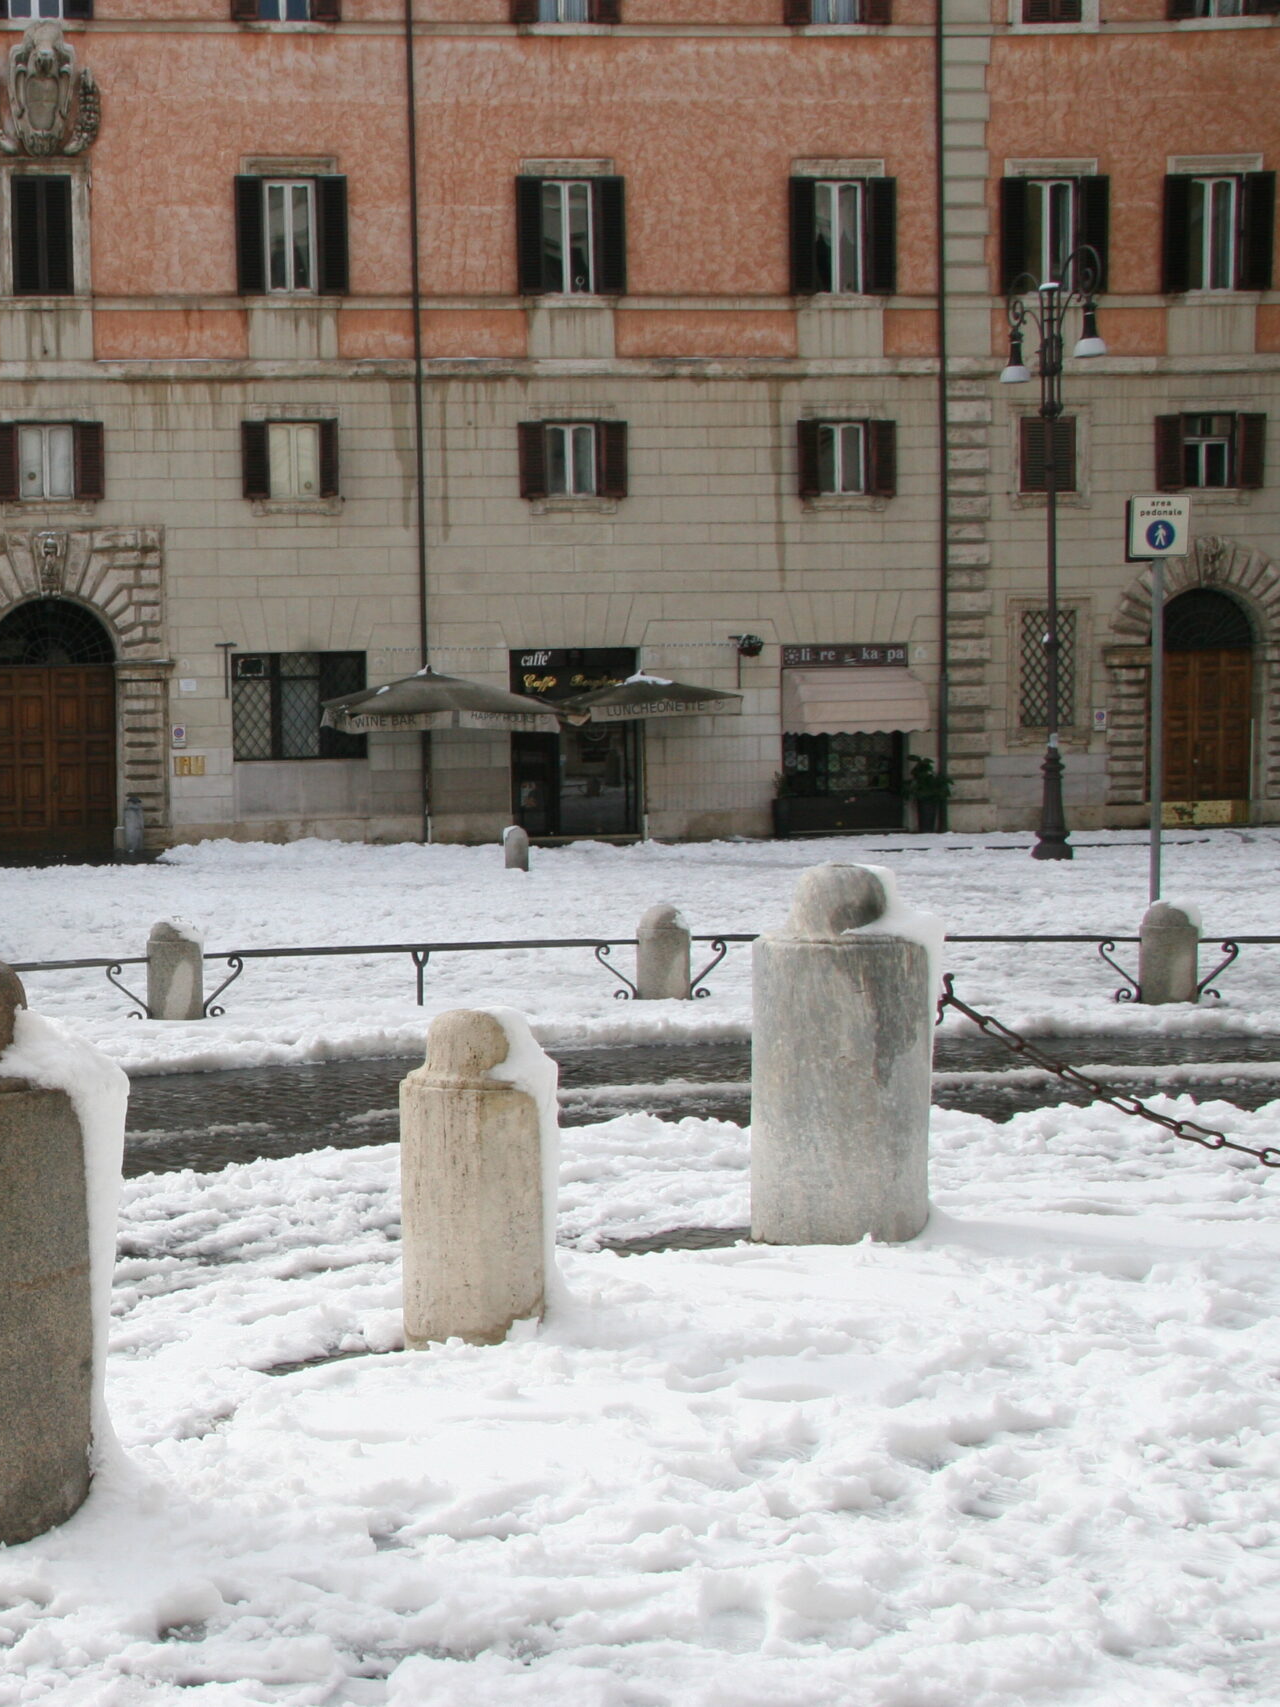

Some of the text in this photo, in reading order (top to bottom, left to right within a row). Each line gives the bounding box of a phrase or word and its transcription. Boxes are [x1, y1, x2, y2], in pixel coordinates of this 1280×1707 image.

[1140, 508, 1183, 517] pedonale
[606, 701, 706, 717] LUNCHEONETTE
[355, 713, 386, 729] WINE
[391, 712, 417, 727] BAR
